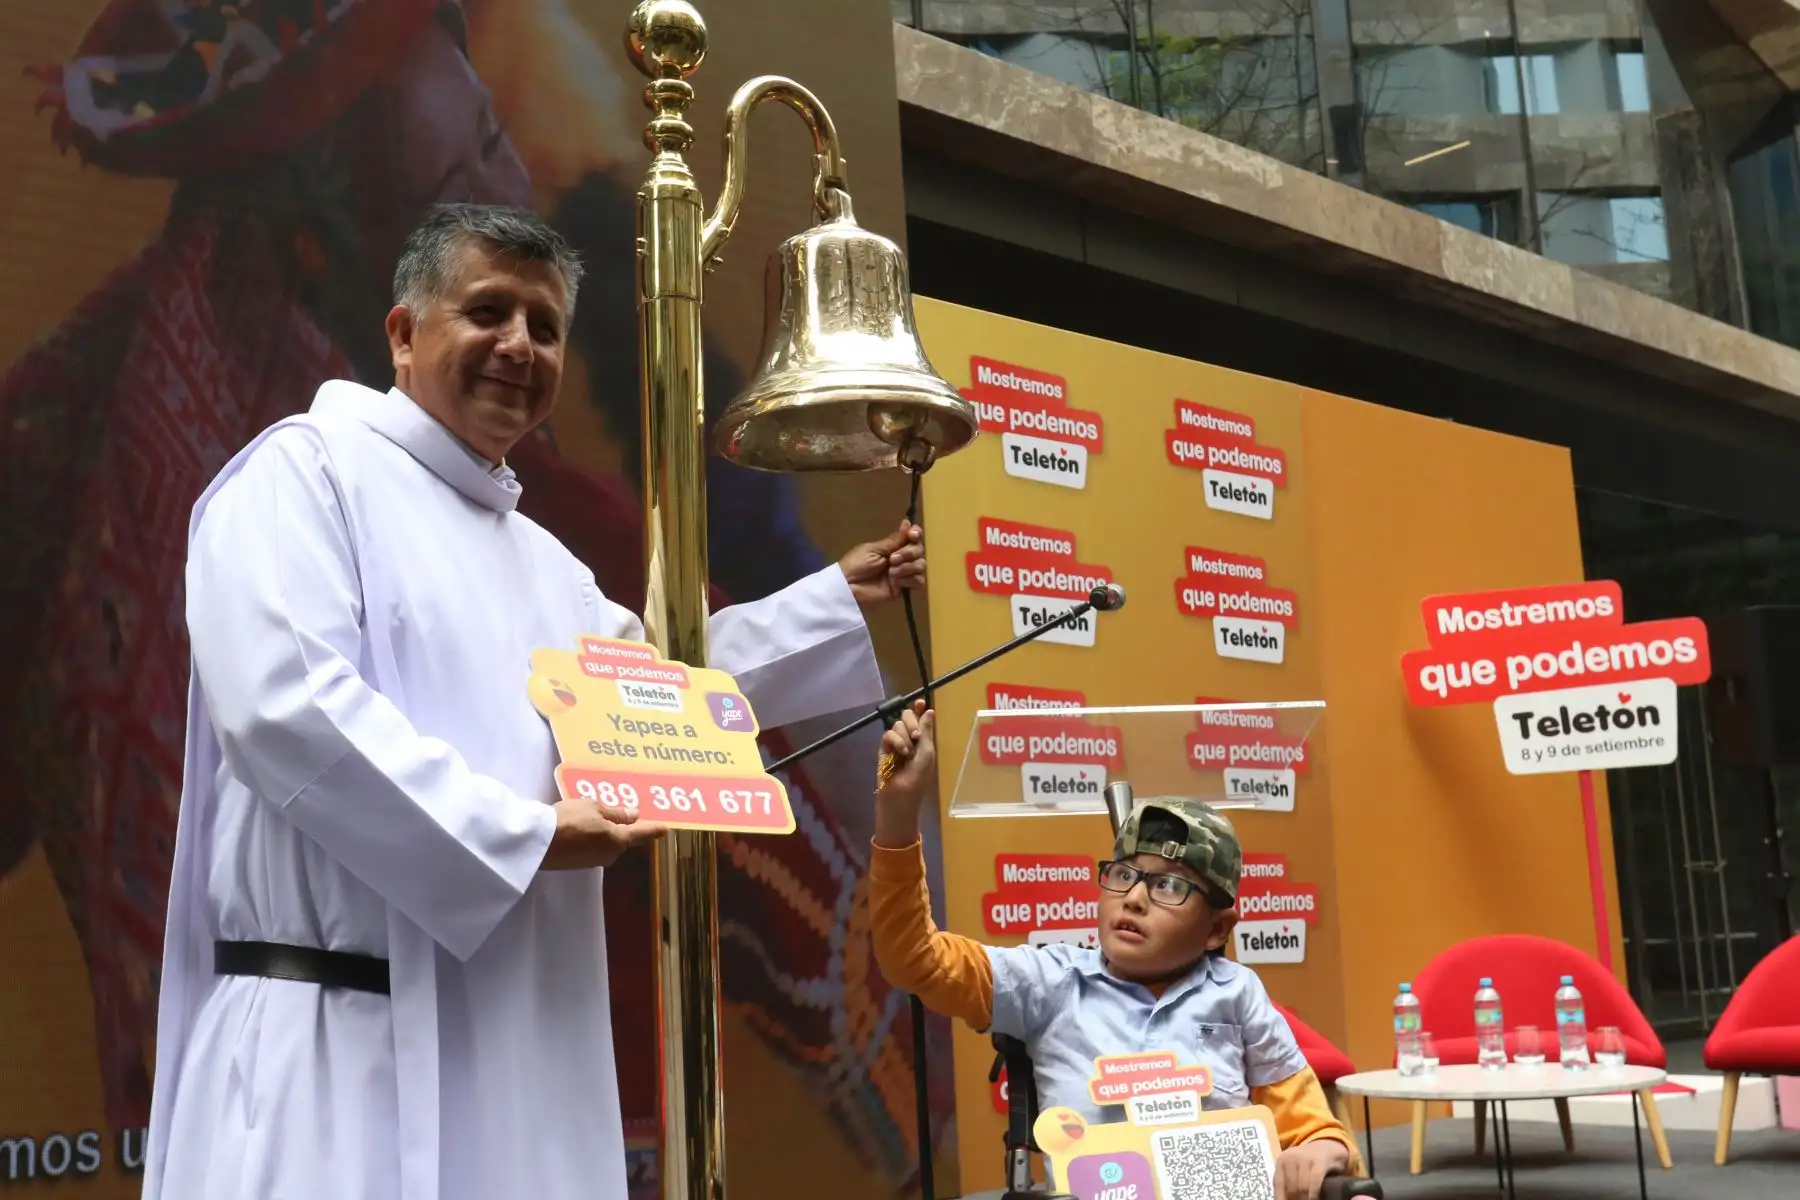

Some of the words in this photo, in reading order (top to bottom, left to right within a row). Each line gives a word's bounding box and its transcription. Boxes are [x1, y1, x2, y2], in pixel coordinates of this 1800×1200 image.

[977, 365, 1063, 399] Mostremos
[1009, 407, 1098, 440] podemos
[1181, 408, 1252, 437] Mostremos
[1172, 439, 1204, 465] que
[1208, 445, 1282, 475] podemos
[985, 527, 1072, 556] Mostremos
[974, 563, 1014, 588] que
[1191, 555, 1263, 580] Mostremos
[1183, 587, 1216, 610] que
[1219, 590, 1293, 617] podemos
[1436, 595, 1614, 635] Mostremos
[588, 643, 652, 661] Mostremos
[585, 660, 614, 677] que
[616, 663, 685, 682] podemos
[1419, 657, 1497, 698] que
[1506, 637, 1698, 690] podemos
[607, 712, 679, 738] Yapea
[683, 724, 698, 738] a
[1202, 711, 1274, 729] Mostremos
[588, 739, 638, 758] este
[643, 741, 735, 766] número:
[987, 736, 1025, 758] que
[1029, 731, 1118, 758] podemos
[1194, 743, 1226, 764] que
[1230, 741, 1304, 765] podemos
[1521, 747, 1531, 761] 8
[1535, 749, 1543, 763] y
[1547, 745, 1557, 758] 9
[1561, 742, 1581, 757] de
[1585, 734, 1665, 755] setiembre
[576, 779, 639, 810] 989
[649, 784, 707, 812] 361
[718, 789, 772, 815] 677
[1003, 863, 1091, 883] Mostremos
[992, 903, 1032, 928] que
[1036, 897, 1098, 927] podem
[1239, 893, 1314, 918] podemos
[1104, 1059, 1172, 1075] Mostremos
[1099, 1083, 1130, 1099] que
[1132, 1073, 1205, 1095] podemos
